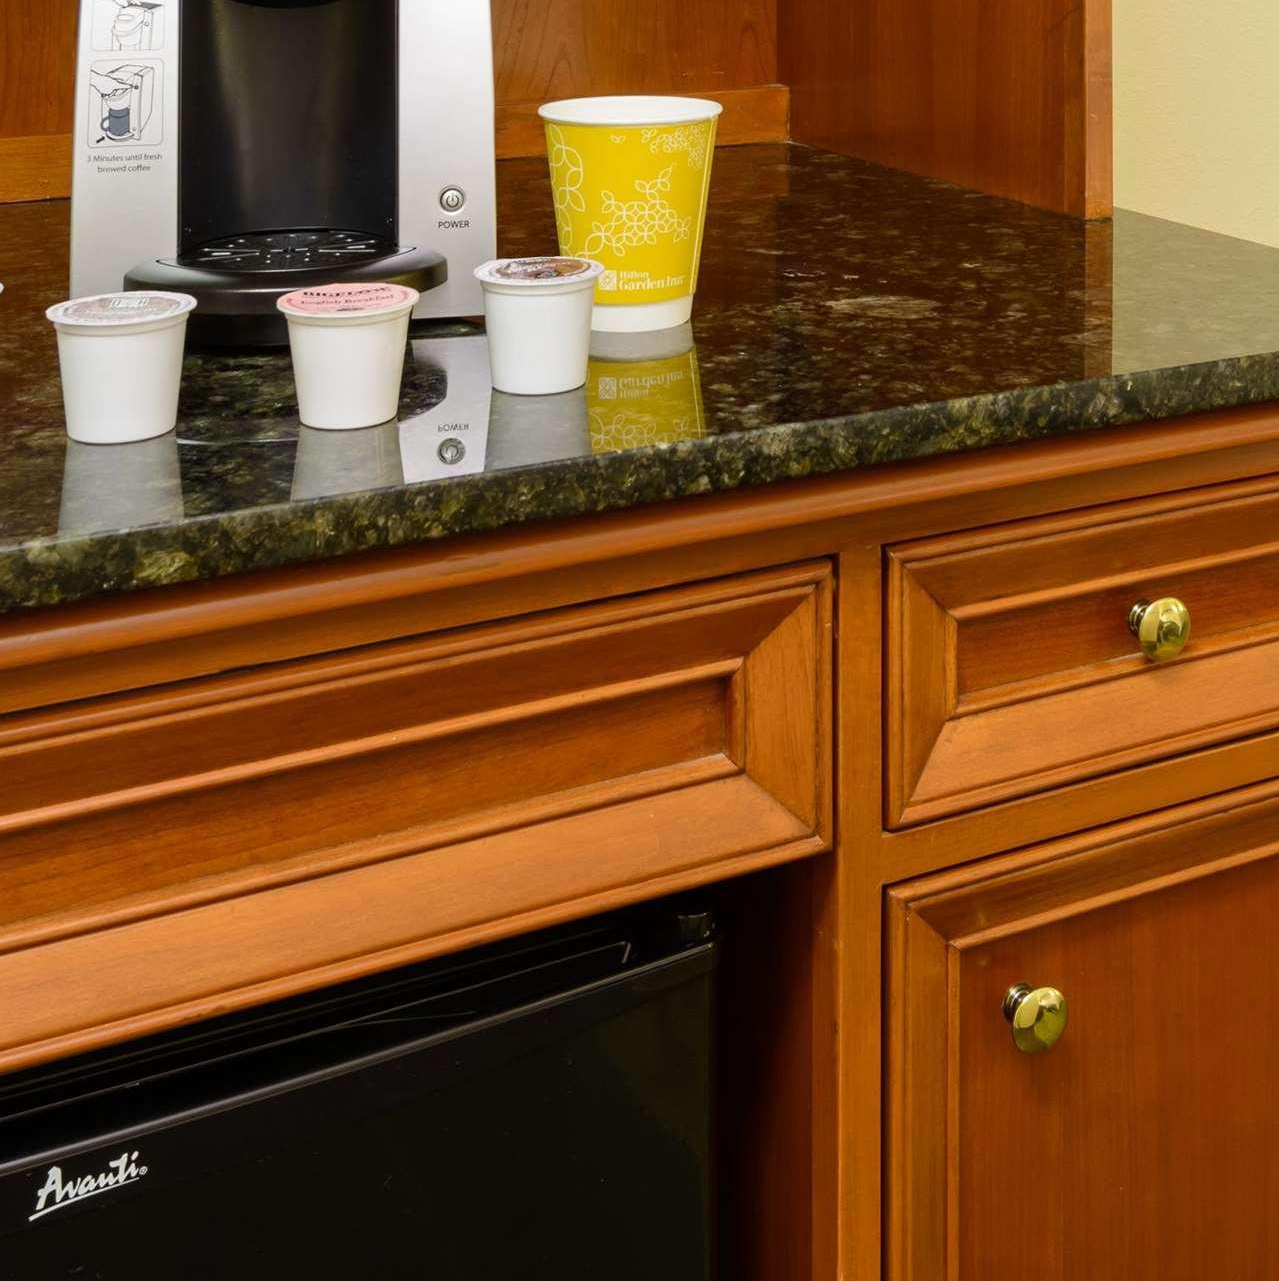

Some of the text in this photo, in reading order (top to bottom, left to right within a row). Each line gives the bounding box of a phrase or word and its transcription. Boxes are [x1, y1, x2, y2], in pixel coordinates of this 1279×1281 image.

[125, 153, 142, 161] until
[97, 163, 152, 173] brewed coffee
[438, 220, 470, 229] POWER
[619, 278, 665, 291] Garden
[35, 1151, 140, 1211] Avanti
